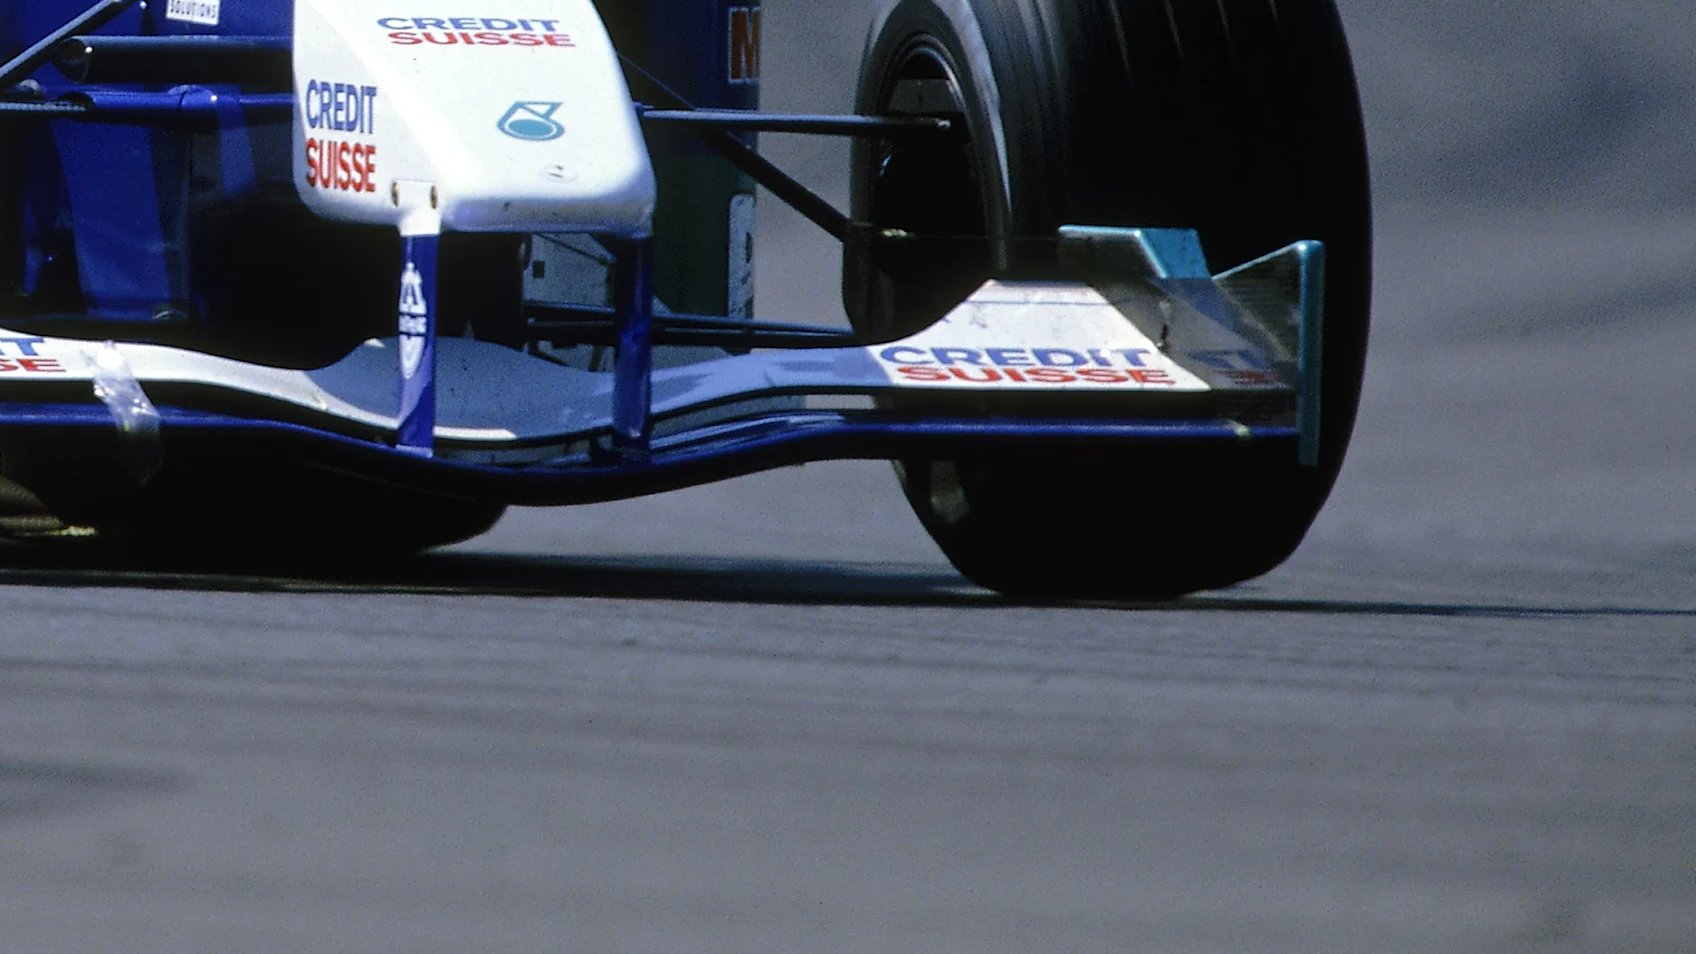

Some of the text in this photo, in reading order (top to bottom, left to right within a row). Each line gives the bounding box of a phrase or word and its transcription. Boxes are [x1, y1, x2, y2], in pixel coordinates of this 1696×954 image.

[377, 17, 561, 31] CREDIT
[388, 31, 576, 47] SUISSE
[306, 79, 378, 135] CREDIT
[306, 138, 377, 193] SUISSE
[878, 347, 1151, 367] CREDIT
[902, 365, 1177, 384] SUISSE
